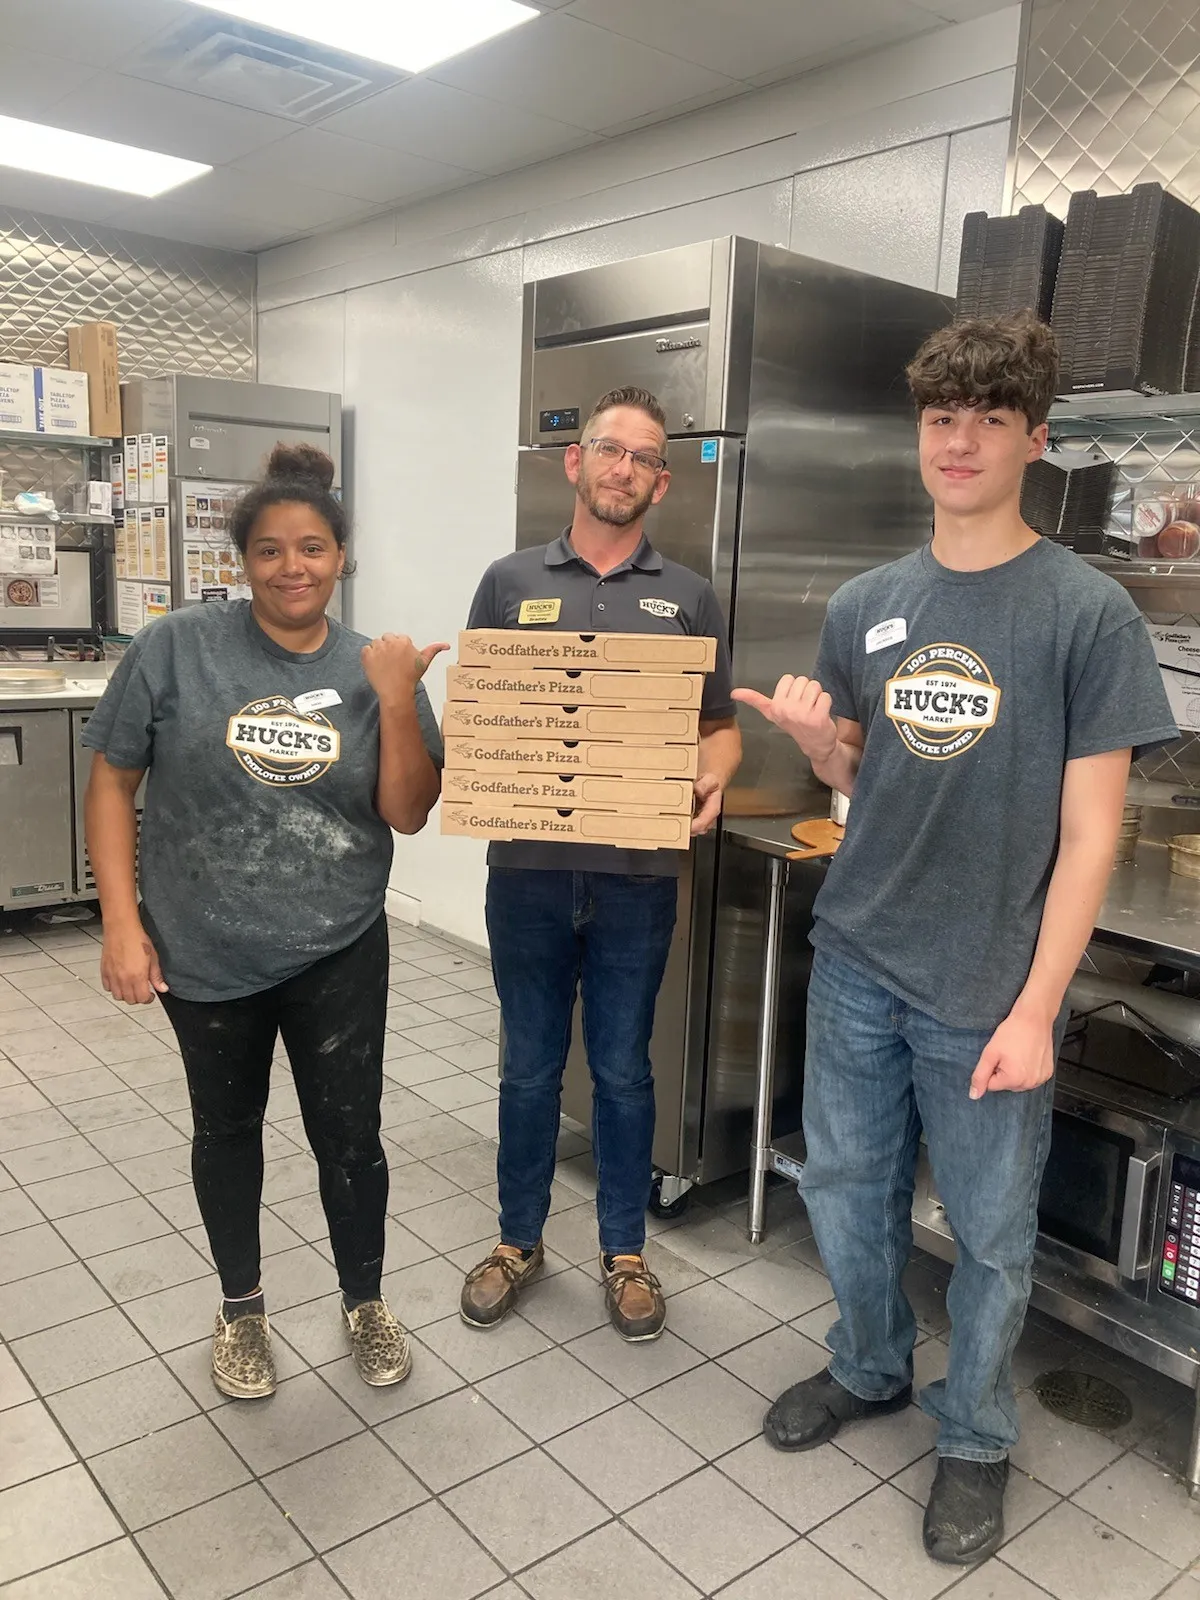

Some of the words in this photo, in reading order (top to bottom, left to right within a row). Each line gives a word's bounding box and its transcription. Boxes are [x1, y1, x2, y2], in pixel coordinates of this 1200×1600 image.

[642, 601, 676, 615] HUCK'S
[489, 644, 560, 658] Godfather's
[562, 646, 597, 658] Pizza
[906, 654, 926, 672] 100
[930, 648, 982, 675] PERCENT
[476, 679, 546, 692] Godfather's
[549, 682, 583, 694] Pizza
[251, 702, 270, 714] 100
[272, 698, 322, 721] PERCNT
[894, 689, 988, 717] HUCK'S
[473, 714, 543, 728] Godfather's
[546, 717, 580, 729] Pizza
[923, 715, 953, 724] MARKET
[235, 723, 332, 752] HUCK'S
[901, 723, 940, 754] EMPLOYEE
[942, 731, 973, 753] OWNED
[269, 748, 298, 756] MARKET
[474, 749, 543, 762] Godfather's
[546, 751, 580, 764] Pizza
[242, 754, 286, 781] EMPLOYEE
[289, 763, 320, 781] OWNED
[471, 781, 539, 795] Godfather's
[542, 785, 576, 797] Pizza
[470, 815, 537, 829] Godfather's
[540, 820, 574, 832] Pizza
